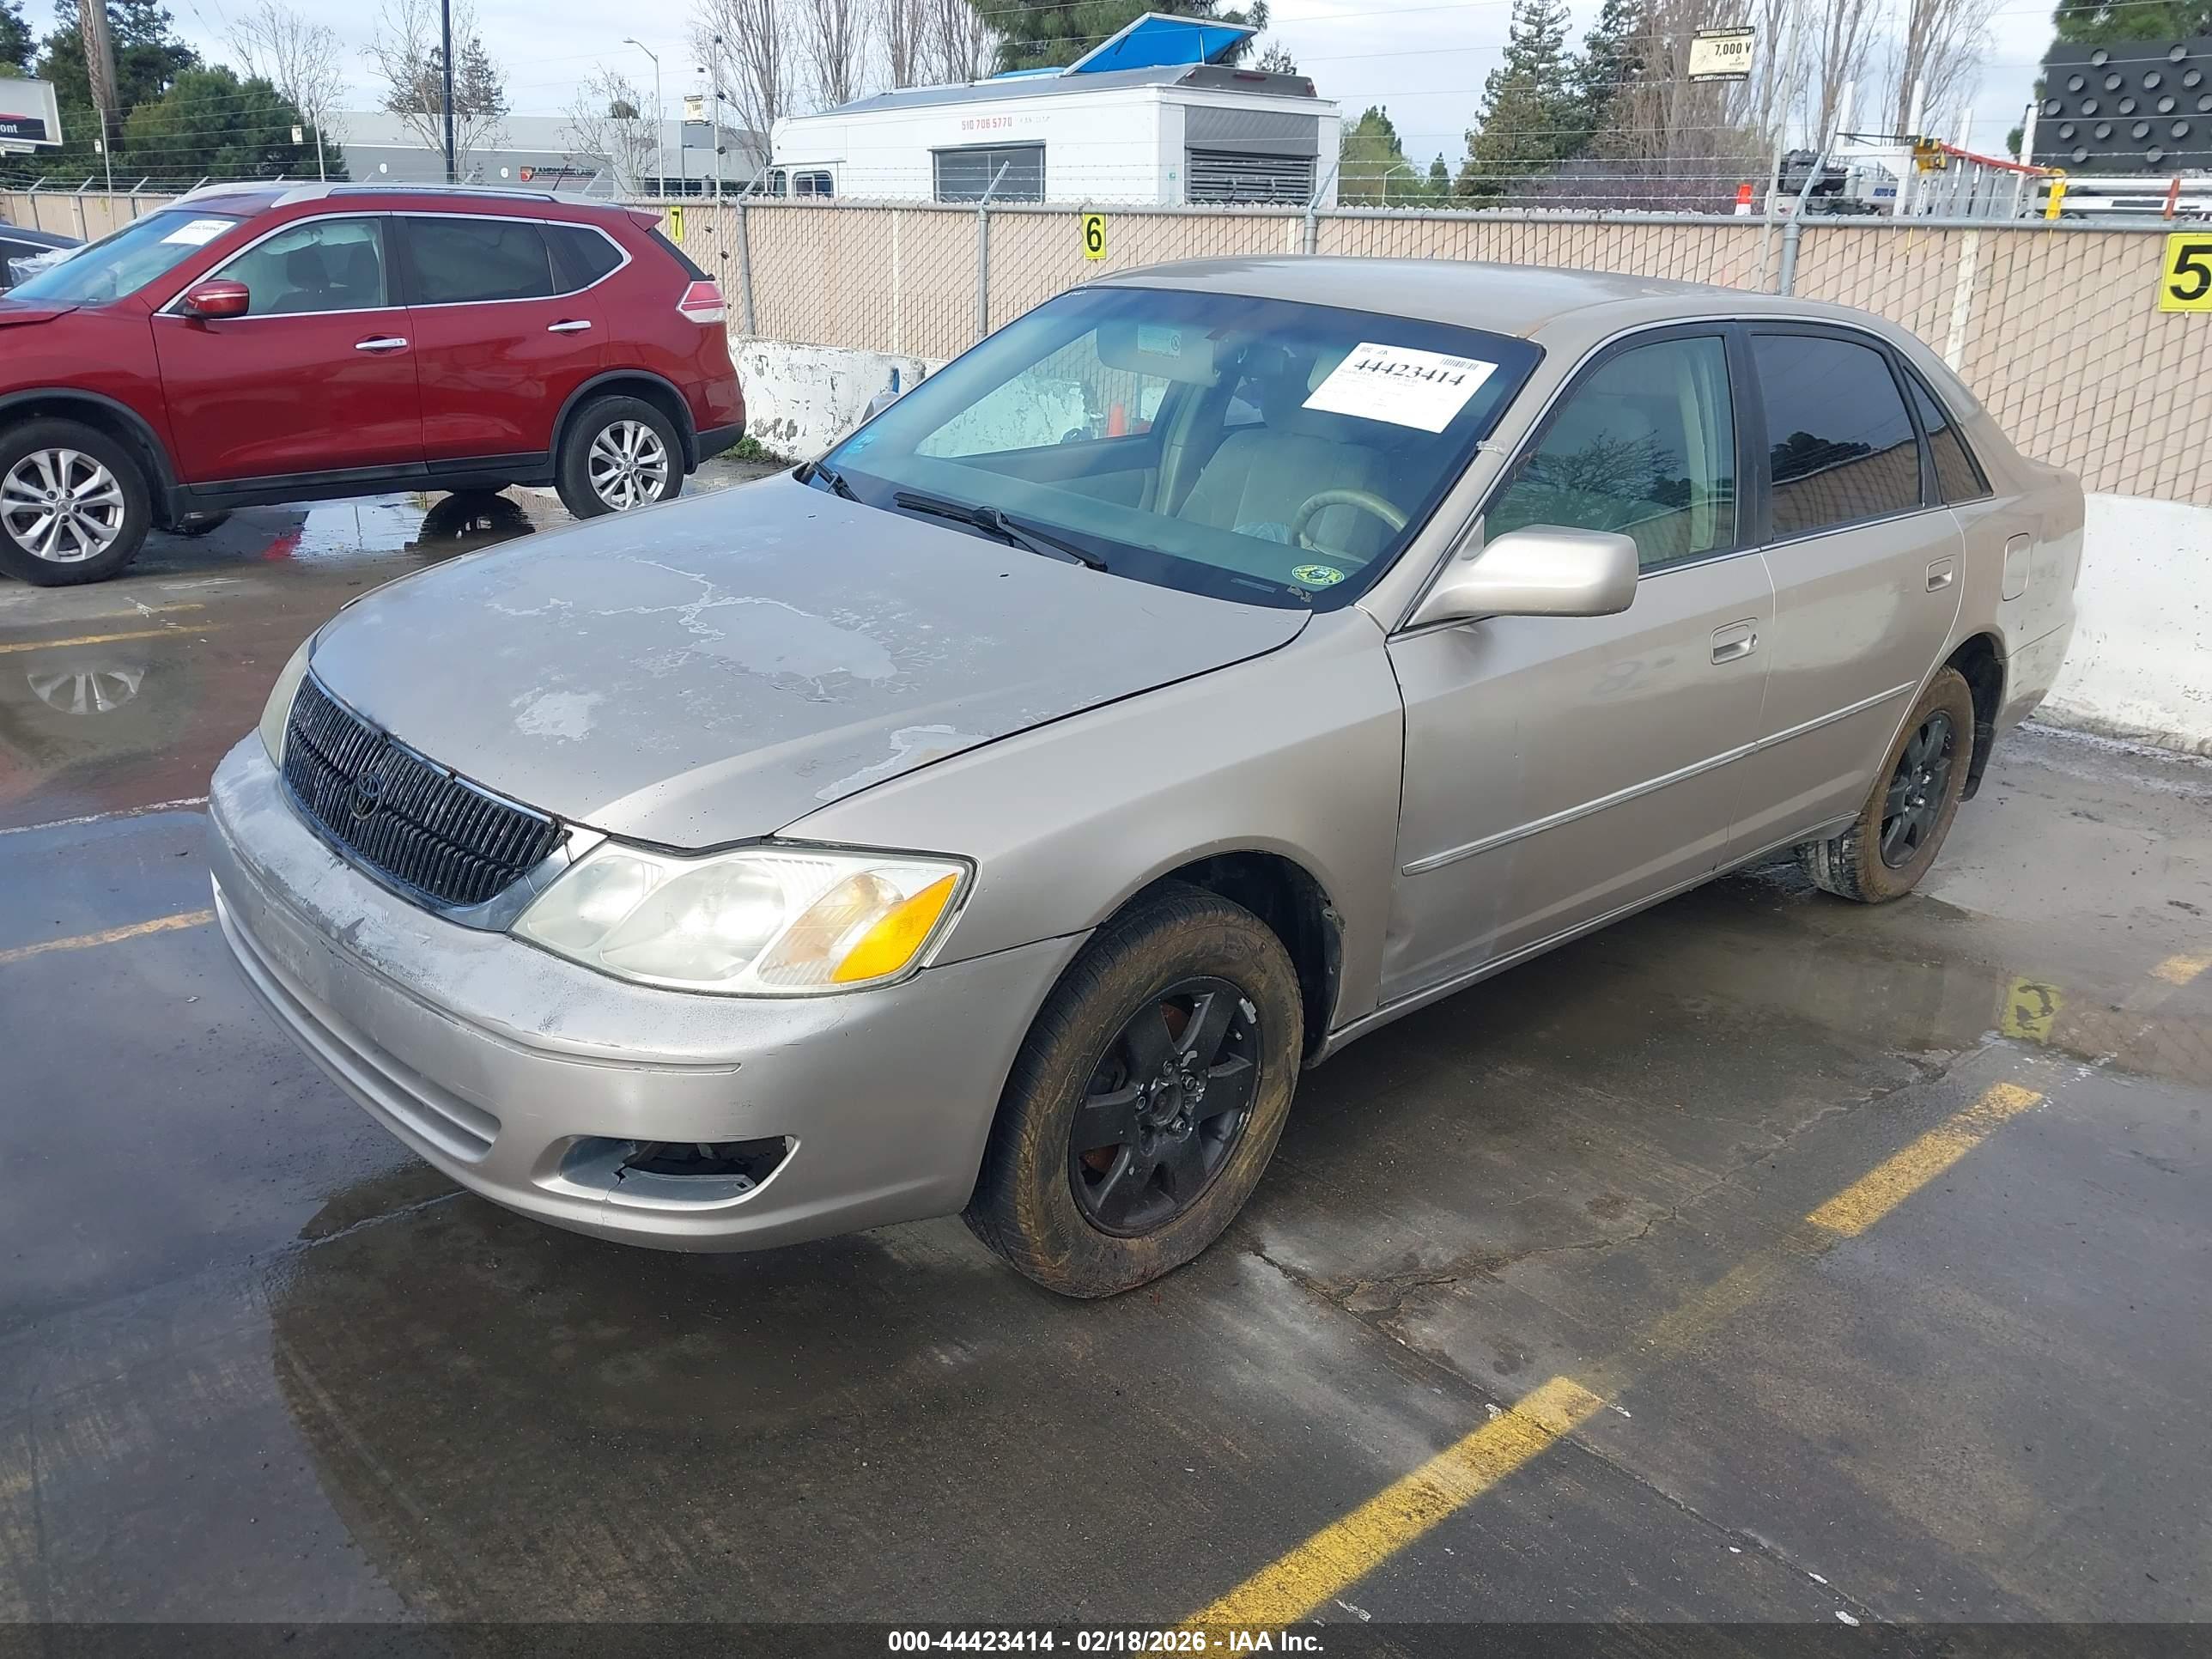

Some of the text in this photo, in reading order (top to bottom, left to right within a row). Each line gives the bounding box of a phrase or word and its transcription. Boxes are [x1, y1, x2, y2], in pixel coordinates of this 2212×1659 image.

[1715, 42, 1751, 57] 7,000 V
[961, 119, 974, 131] 510
[992, 117, 1012, 128] 5770
[672, 210, 679, 237] 7
[1086, 216, 1103, 252] 6
[2169, 245, 2212, 301] 5
[1353, 358, 1467, 386] 44423414
